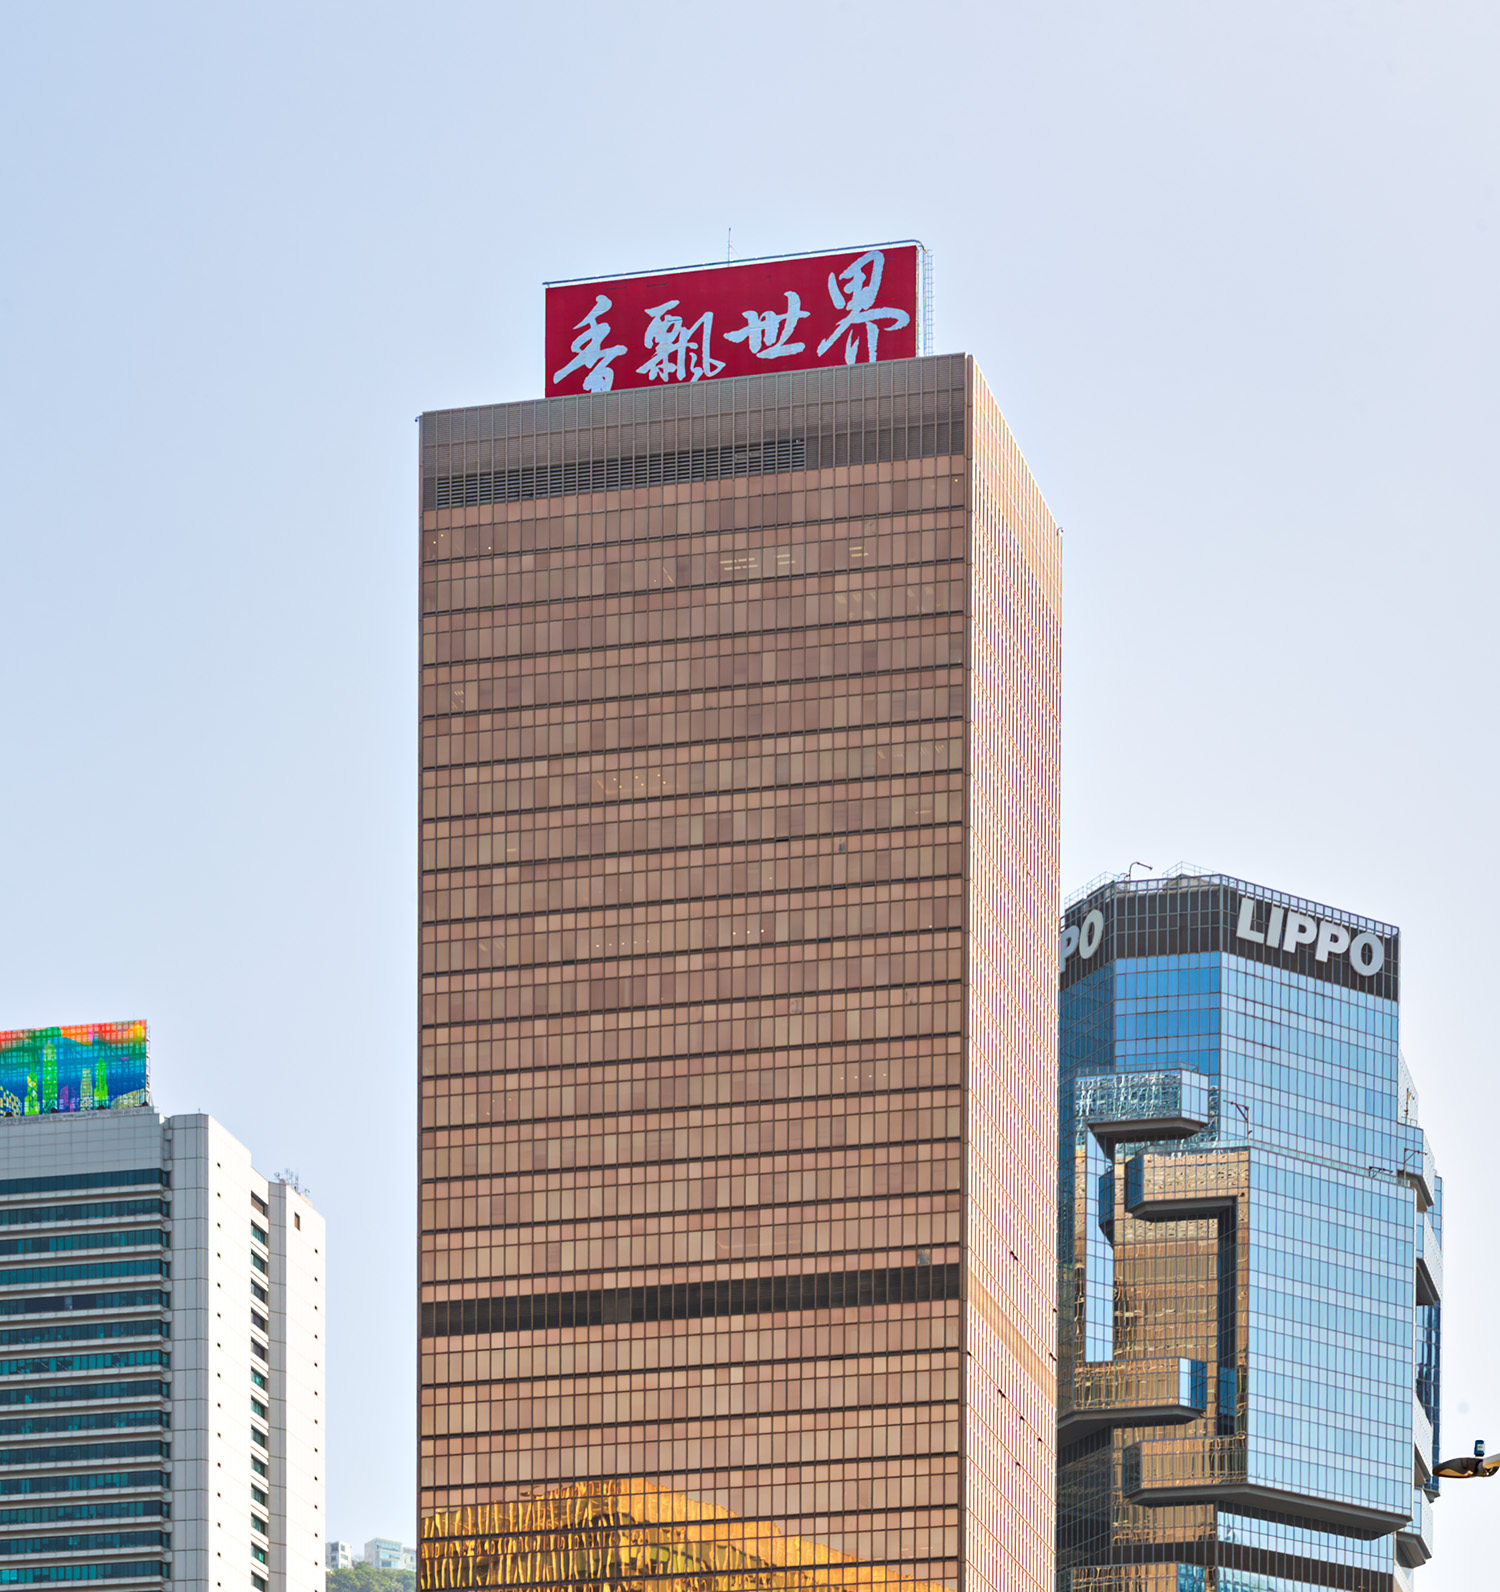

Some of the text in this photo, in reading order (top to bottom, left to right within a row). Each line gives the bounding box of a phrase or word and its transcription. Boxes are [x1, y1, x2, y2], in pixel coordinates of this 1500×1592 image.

[553, 250, 911, 394] 香飄世界
[1236, 897, 1385, 977] LIPPO
